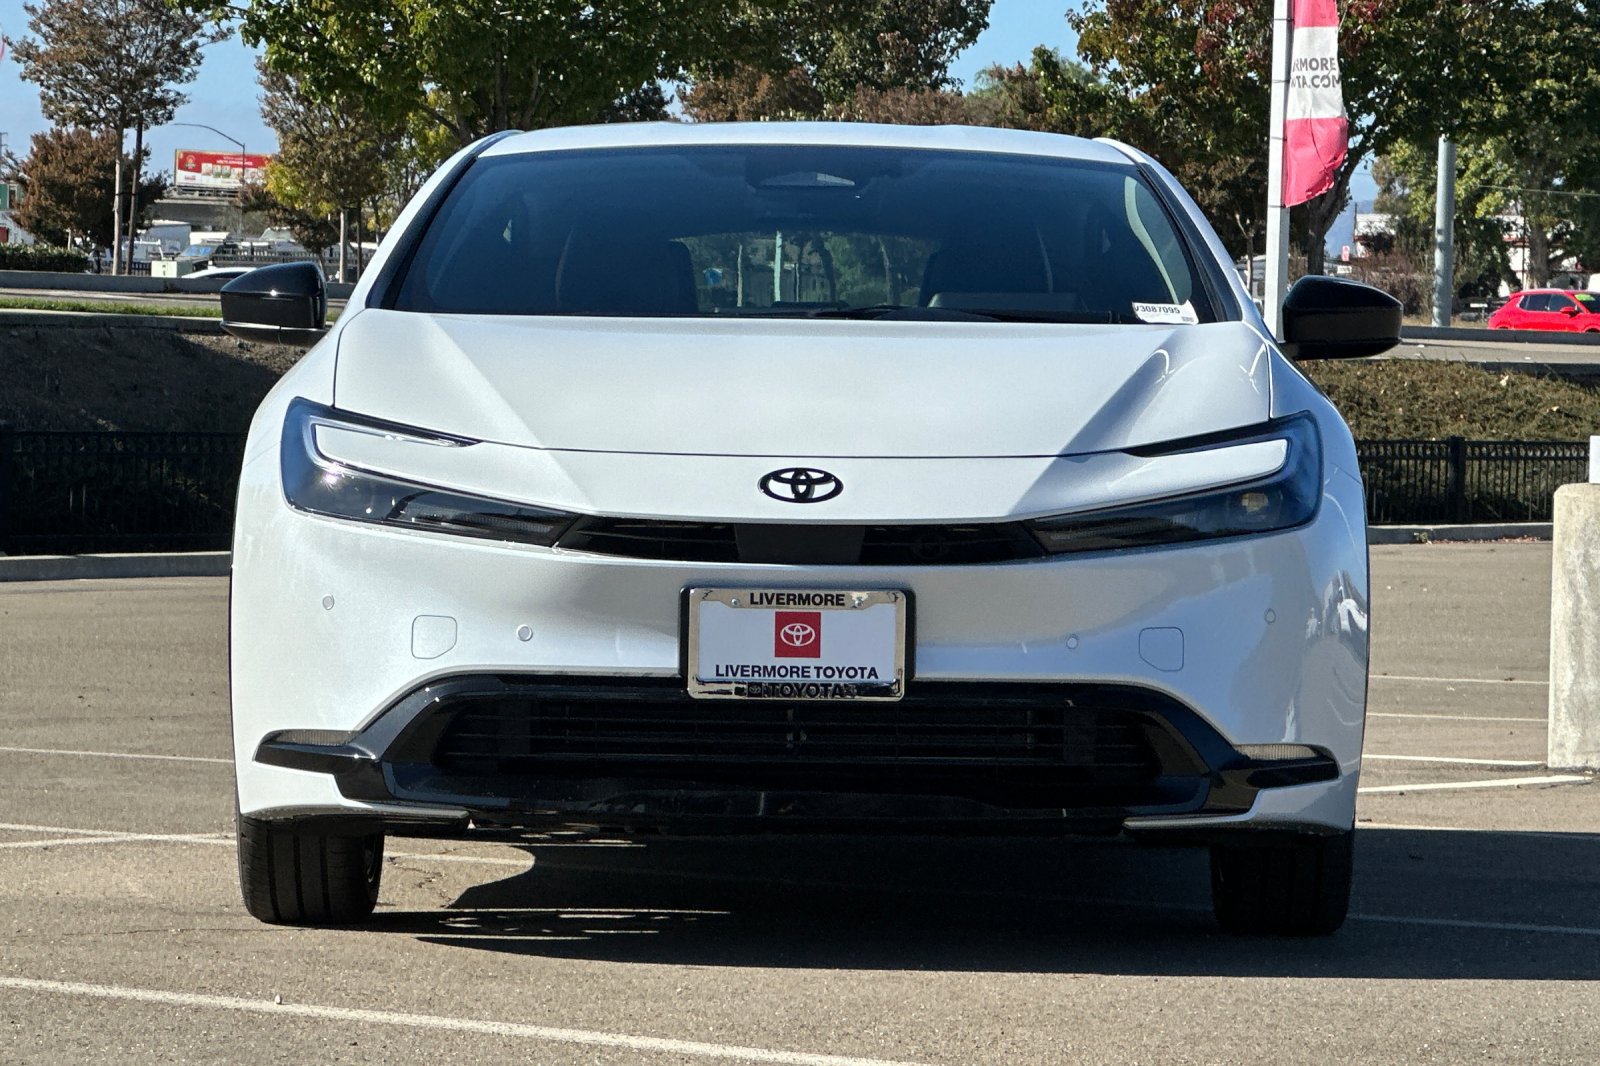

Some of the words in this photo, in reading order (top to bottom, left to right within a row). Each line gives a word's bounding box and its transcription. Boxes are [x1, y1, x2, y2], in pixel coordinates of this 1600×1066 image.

[749, 592, 846, 607] LIVERMORE
[715, 664, 811, 679] LIVERMORE
[814, 666, 879, 679] TOYOTA
[768, 683, 845, 698] TOYOTA
